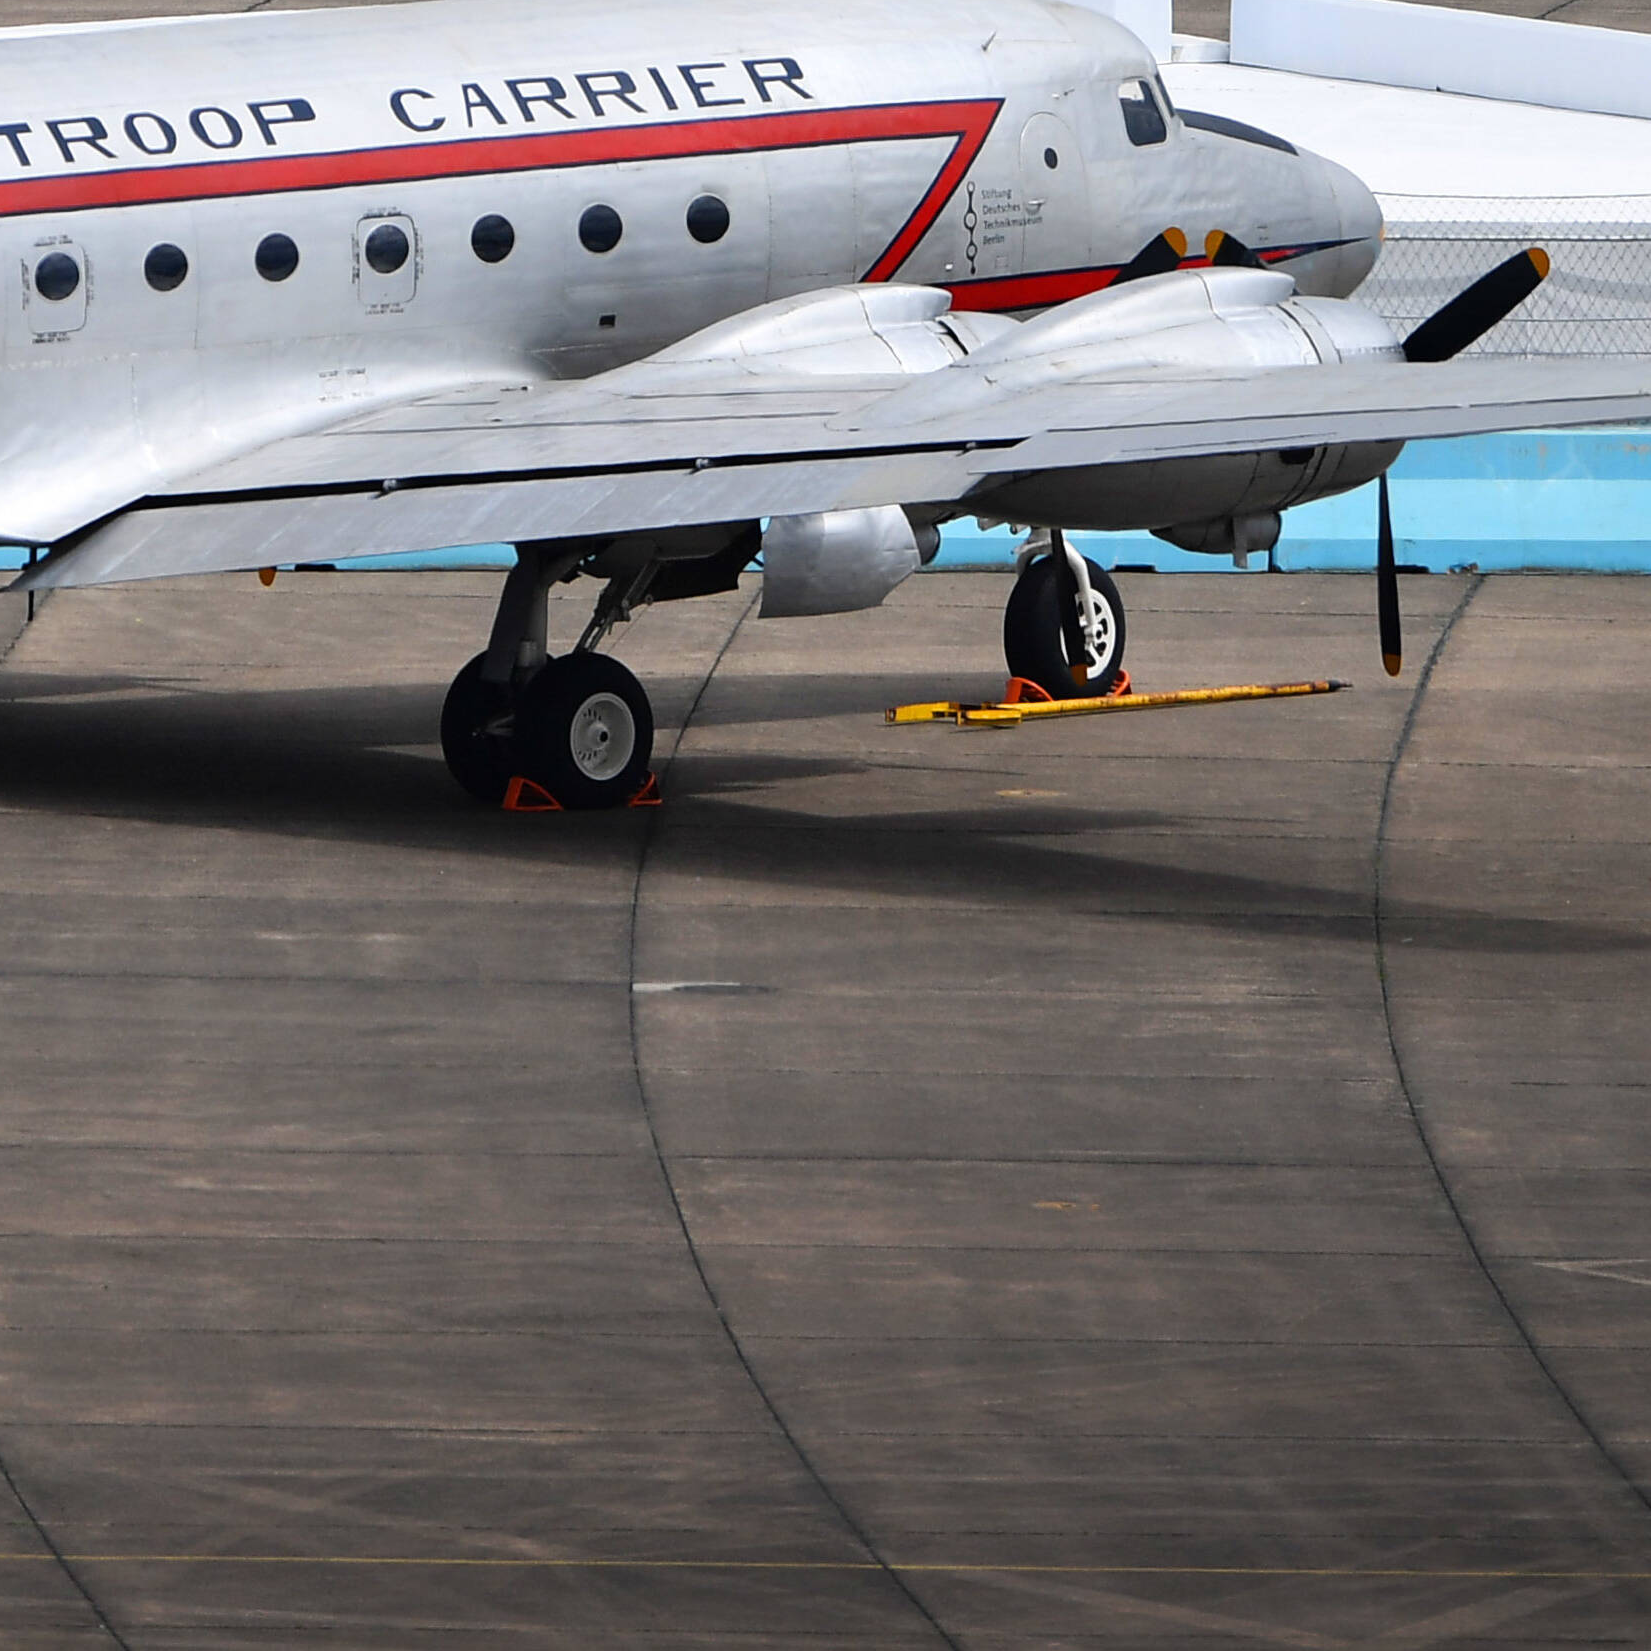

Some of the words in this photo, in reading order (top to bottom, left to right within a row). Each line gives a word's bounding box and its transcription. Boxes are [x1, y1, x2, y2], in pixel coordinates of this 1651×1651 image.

[389, 56, 814, 133] CARRIER
[981, 189, 1013, 200] Stiftung
[982, 203, 1022, 215] Deutsches
[983, 216, 1044, 230] Technikmuseum
[983, 234, 1005, 245] Berlin
